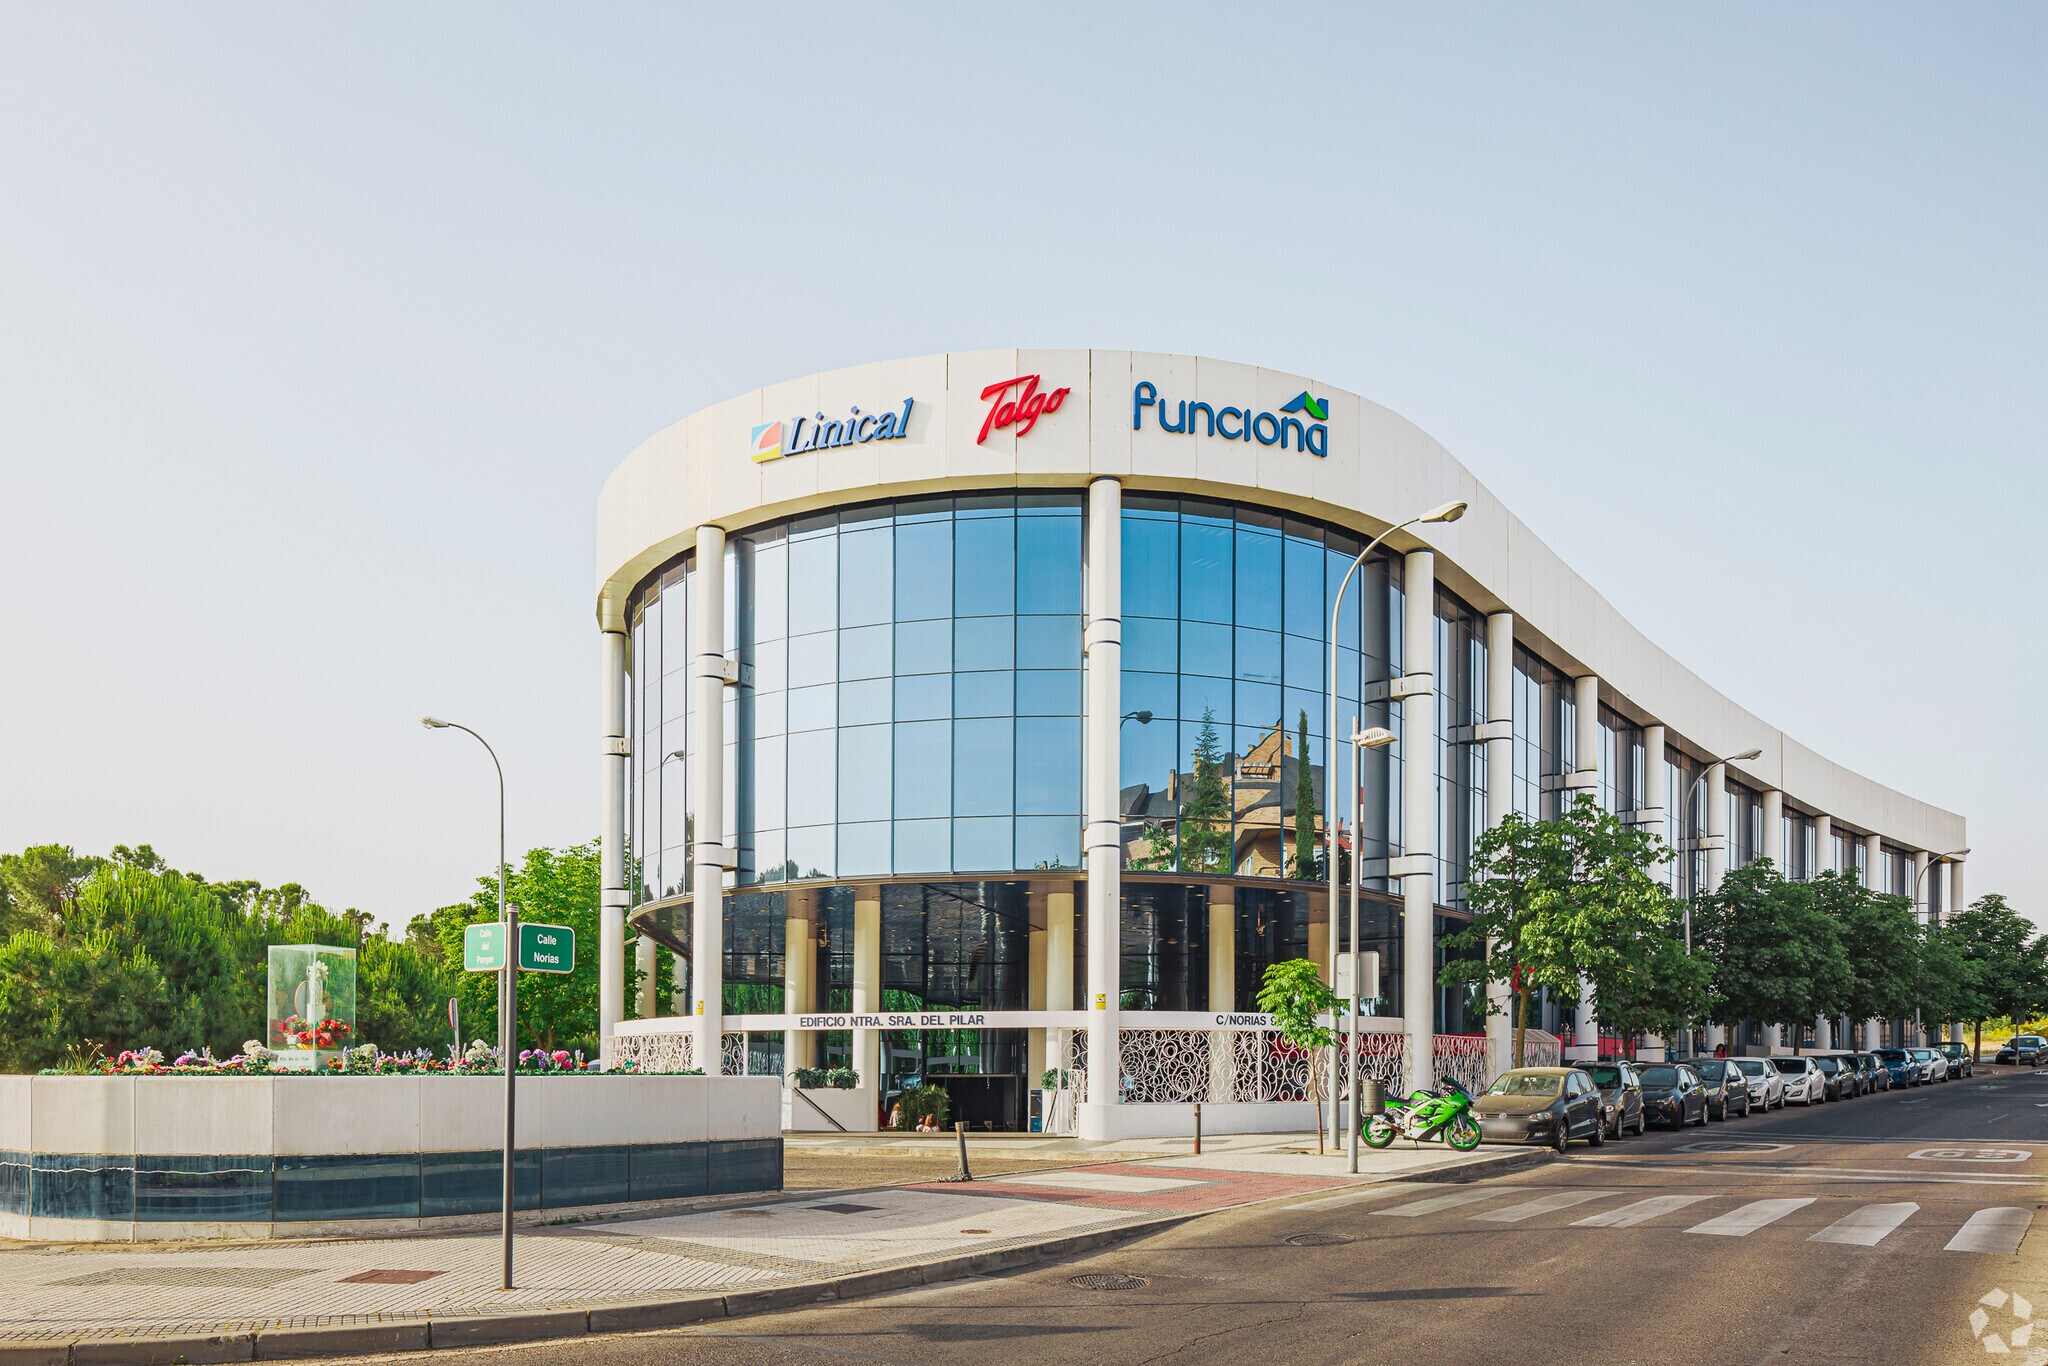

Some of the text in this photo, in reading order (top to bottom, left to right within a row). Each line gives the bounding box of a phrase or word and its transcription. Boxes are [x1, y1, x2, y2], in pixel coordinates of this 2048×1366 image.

[976, 374, 1071, 445] Talgo
[784, 396, 914, 458] Linical
[537, 933, 557, 946] Calle
[533, 952, 560, 964] Norias
[800, 1014, 985, 1028] EDIFICIO NTRA. SRA. DEL PILAR
[1215, 1014, 1267, 1026] C/NORIAS
